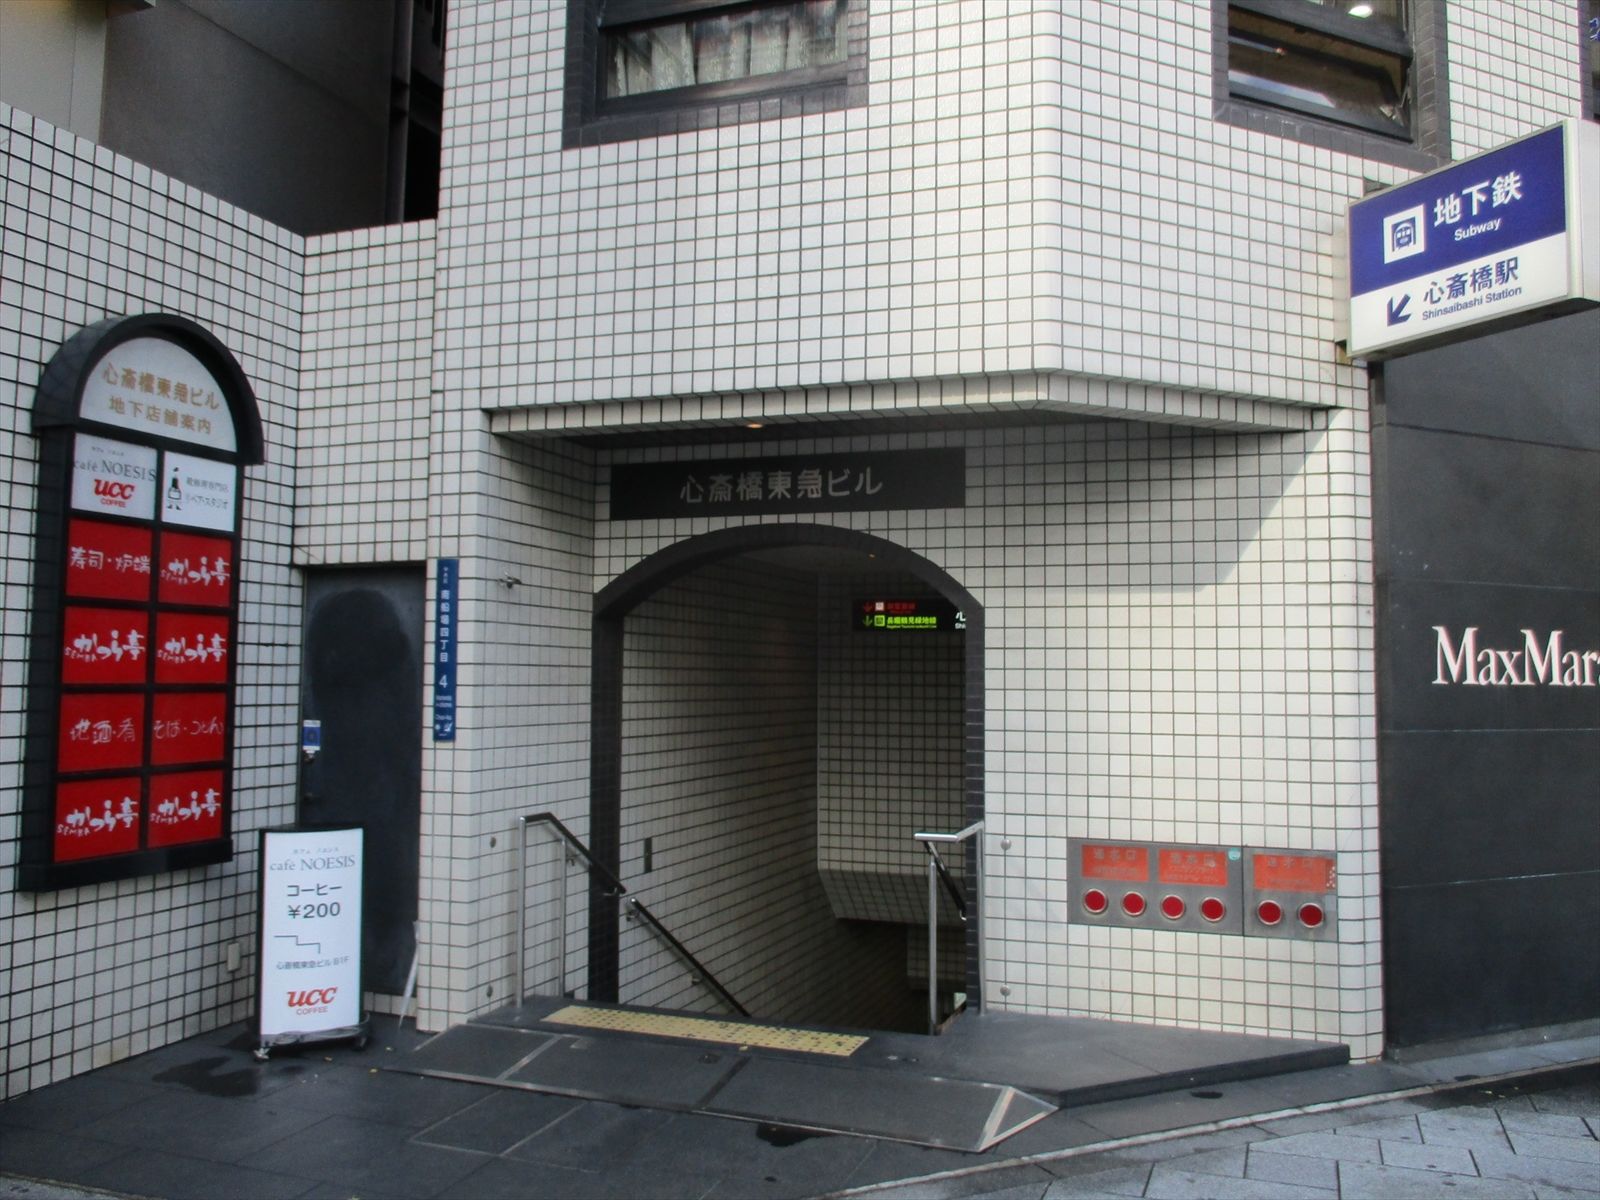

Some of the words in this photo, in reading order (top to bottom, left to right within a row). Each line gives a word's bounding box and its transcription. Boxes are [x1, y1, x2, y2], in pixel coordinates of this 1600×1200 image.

[1434, 171, 1522, 228] 地下鉄
[1454, 217, 1501, 242] Subway
[1423, 256, 1519, 306] 心斎橋駅
[1422, 296, 1483, 321] Shinsaibashi
[1485, 286, 1522, 304] Station
[102, 362, 219, 411] 心斎橋東急ビル
[108, 395, 212, 435] 地下店舗案内
[101, 459, 156, 482] NOESIS
[680, 466, 883, 504] 心斎橋東急ビル
[1432, 625, 1600, 687] MaxMar
[439, 674, 448, 689] 4
[300, 854, 356, 871] NOESIS
[287, 883, 343, 897] コーヒー
[287, 901, 341, 919] ¥200
[296, 1006, 328, 1015] COFFEE
